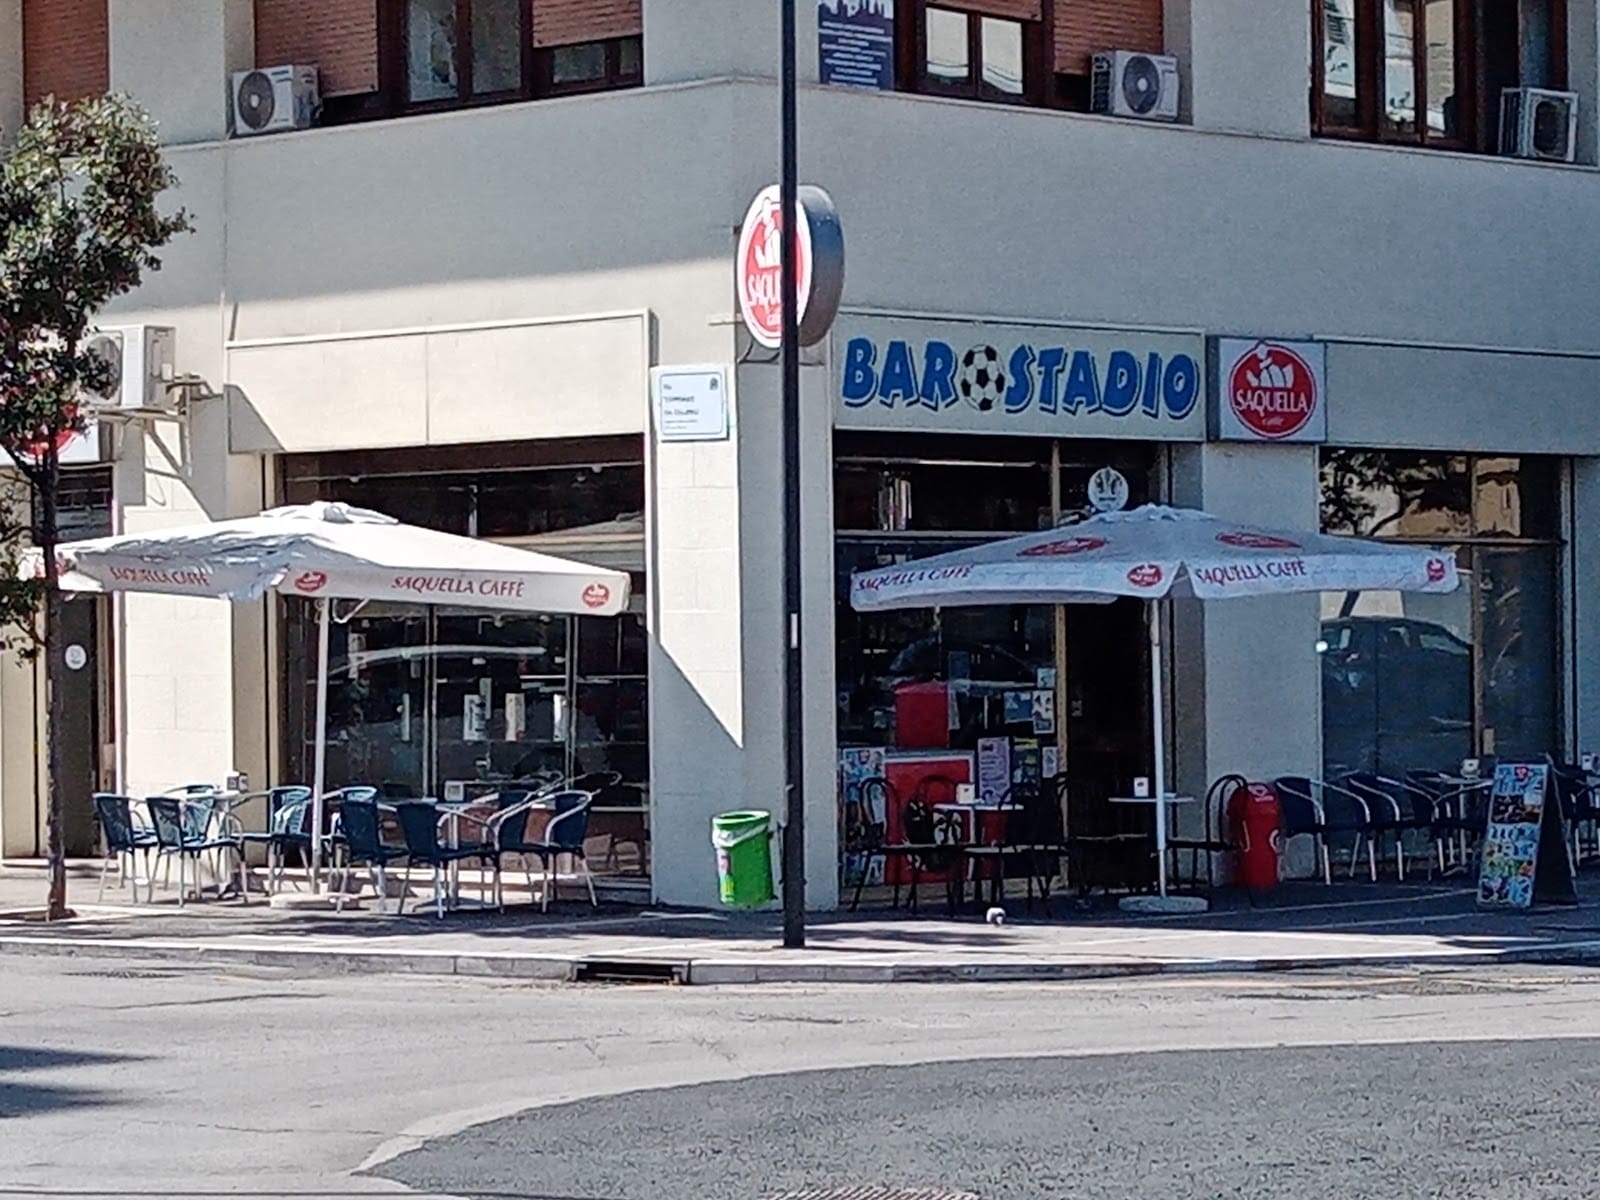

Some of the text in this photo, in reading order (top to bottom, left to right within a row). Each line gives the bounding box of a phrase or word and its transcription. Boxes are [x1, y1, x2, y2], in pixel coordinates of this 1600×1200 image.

[842, 337, 1200, 420] BAR STADIO
[1234, 389, 1308, 417] SAQUELLA
[391, 575, 526, 598] SAQUELLA CAFFÈ
[1194, 562, 1268, 586] SAQUELLA
